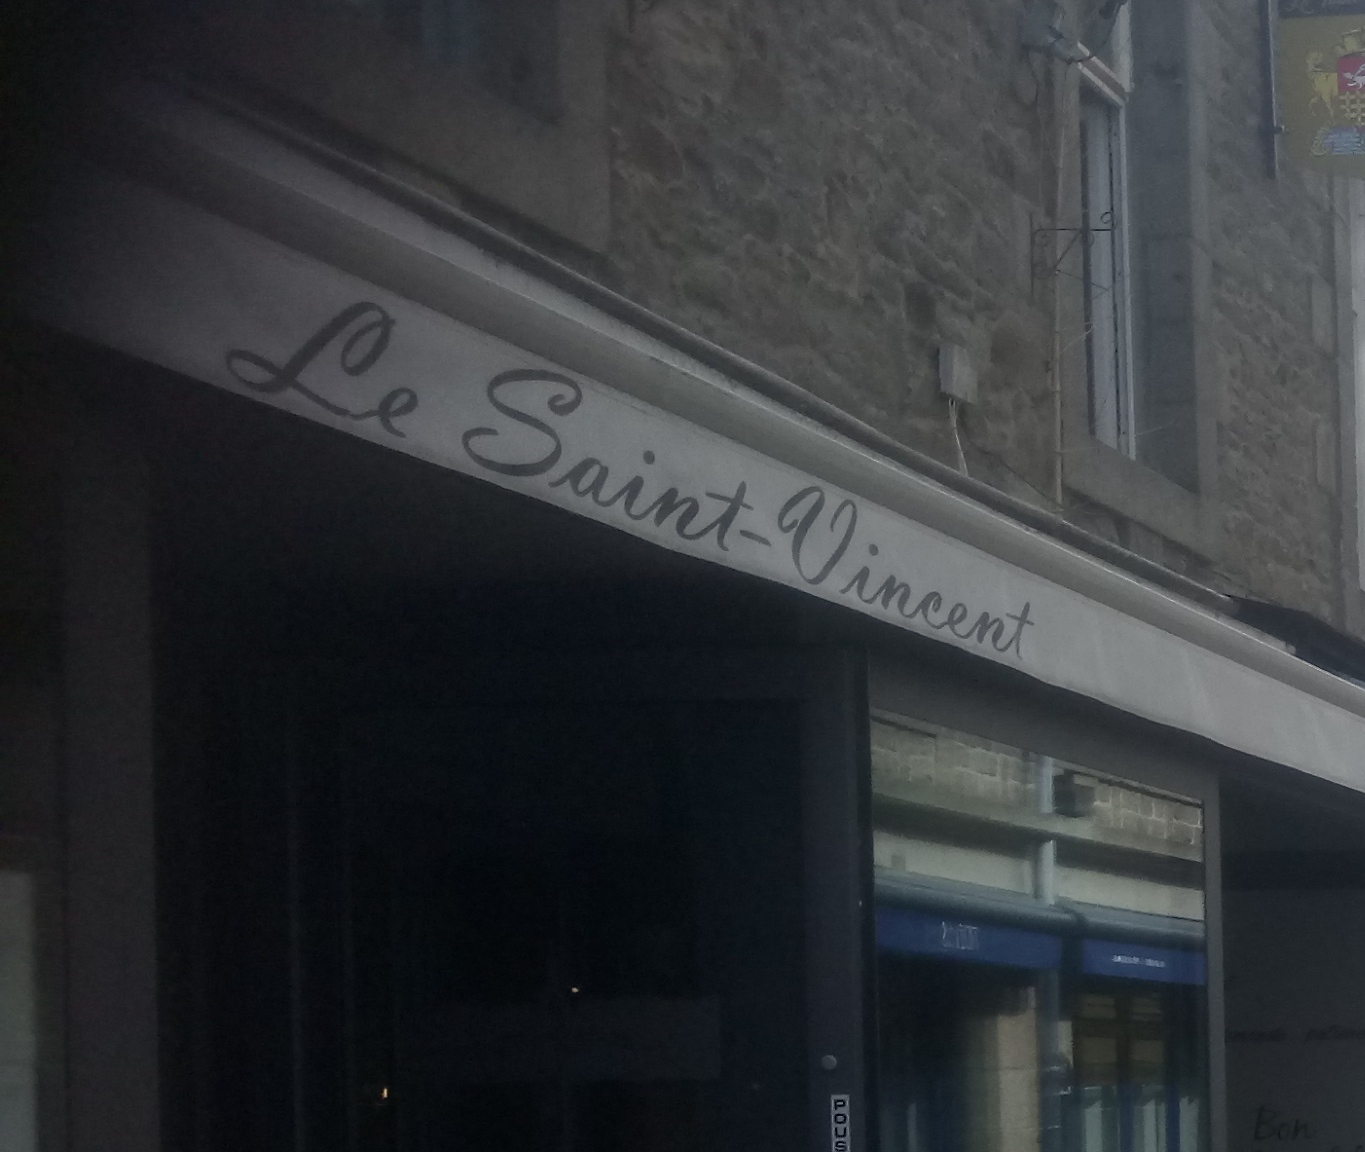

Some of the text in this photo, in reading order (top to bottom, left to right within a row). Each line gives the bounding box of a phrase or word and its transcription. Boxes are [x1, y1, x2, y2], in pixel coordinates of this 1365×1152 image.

[226, 301, 1035, 661] Le Saint-Vincent
[1253, 1104, 1316, 1142] Bon
